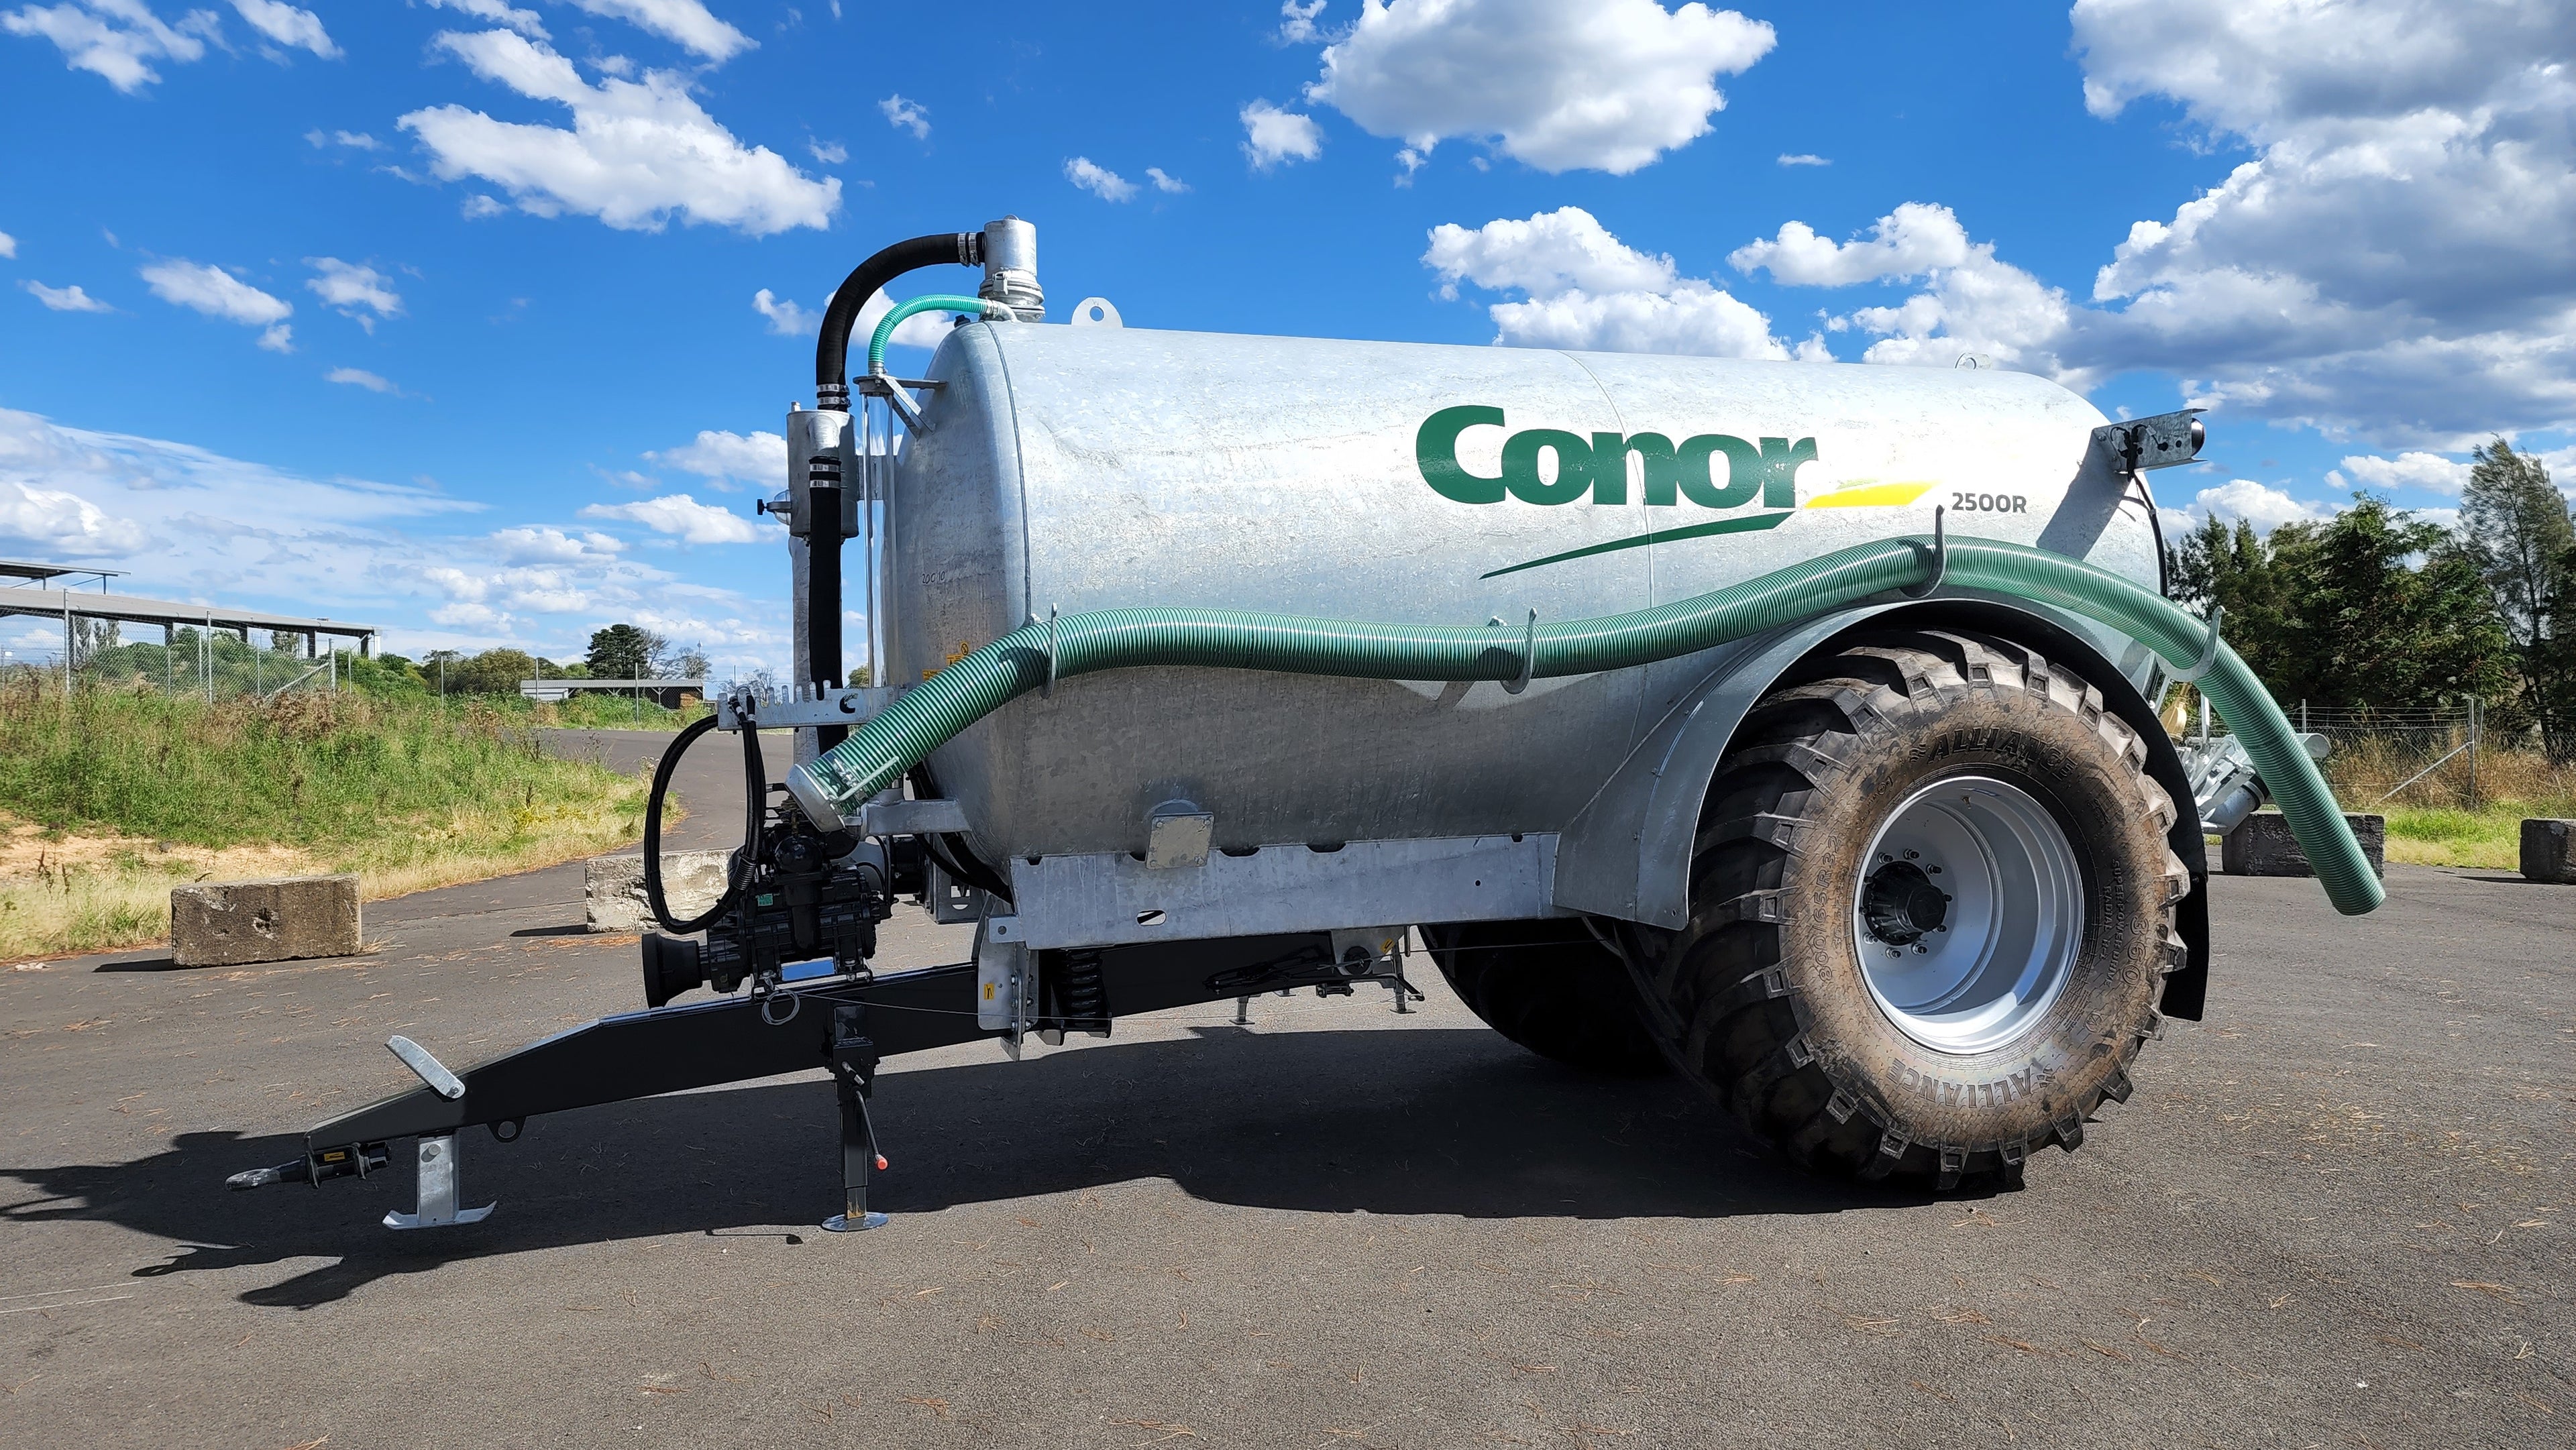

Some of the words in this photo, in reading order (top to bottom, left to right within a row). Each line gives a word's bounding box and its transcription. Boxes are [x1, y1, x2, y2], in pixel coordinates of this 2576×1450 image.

[1416, 405, 1819, 508] Conor
[1951, 492, 2027, 514] 2500R
[1927, 726, 2078, 781] ALLIANCE
[2112, 860, 2125, 901] SUPER
[2103, 885, 2113, 932] RADIAL
[2113, 903, 2125, 948] POWER
[2104, 950, 2120, 987] DRIVE
[2121, 916, 2149, 986] 360
[1886, 1058, 2032, 1108] ALLIANCE
